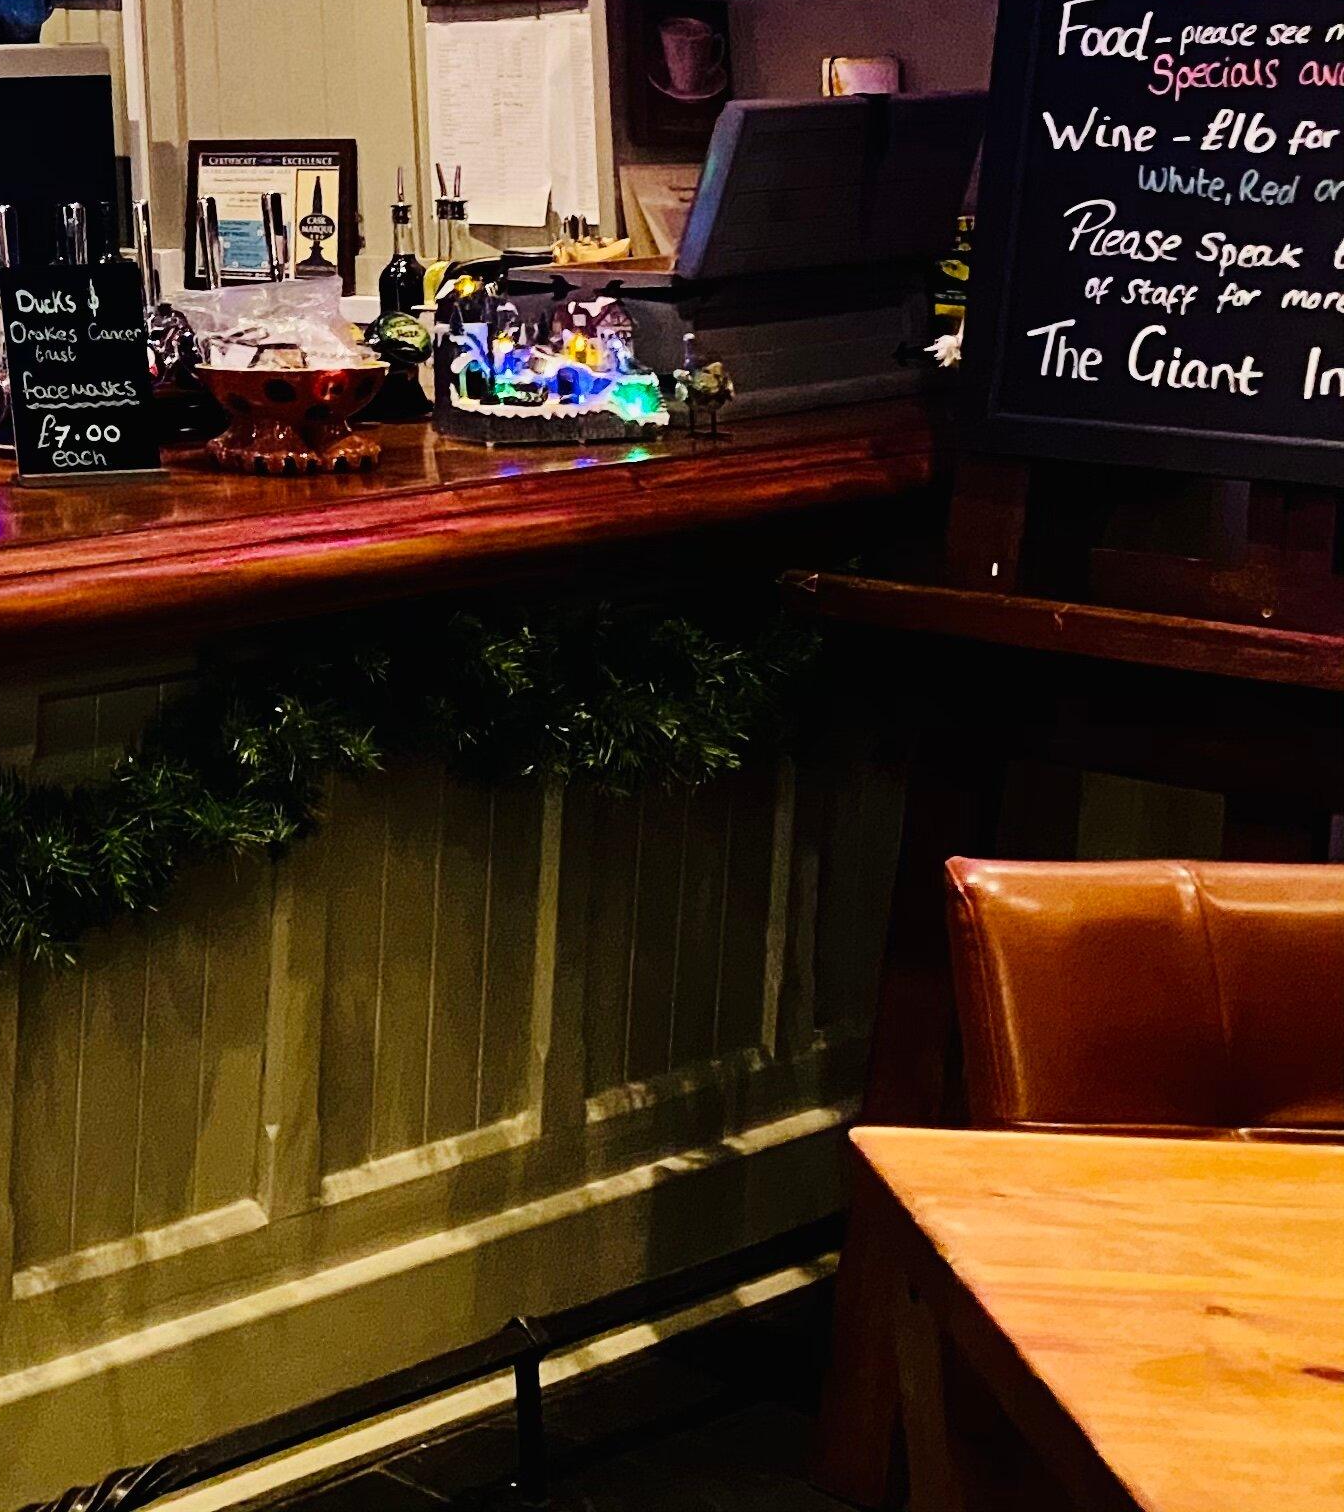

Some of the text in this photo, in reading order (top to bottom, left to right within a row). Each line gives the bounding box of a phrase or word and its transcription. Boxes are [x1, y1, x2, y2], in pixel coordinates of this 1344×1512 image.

[1180, 22, 1257, 55] please
[1265, 23, 1312, 46] see
[1148, 53, 1280, 102] Specials
[1042, 106, 1341, 156] Wine £16 for
[208, 156, 333, 166] CERTIFICATE EXCELLENCE
[1239, 168, 1301, 206] Red
[301, 225, 333, 235] MARQUE
[1062, 199, 1183, 263] Please
[15, 289, 77, 315] Ducks
[1084, 276, 1114, 305] of
[1216, 282, 1263, 314] for
[87, 322, 143, 342] Cancer
[35, 345, 77, 363] trust
[1027, 318, 1264, 397] The Giant
[22, 370, 138, 400] facemasks
[37, 414, 121, 449] £7.00
[52, 449, 108, 468] each
